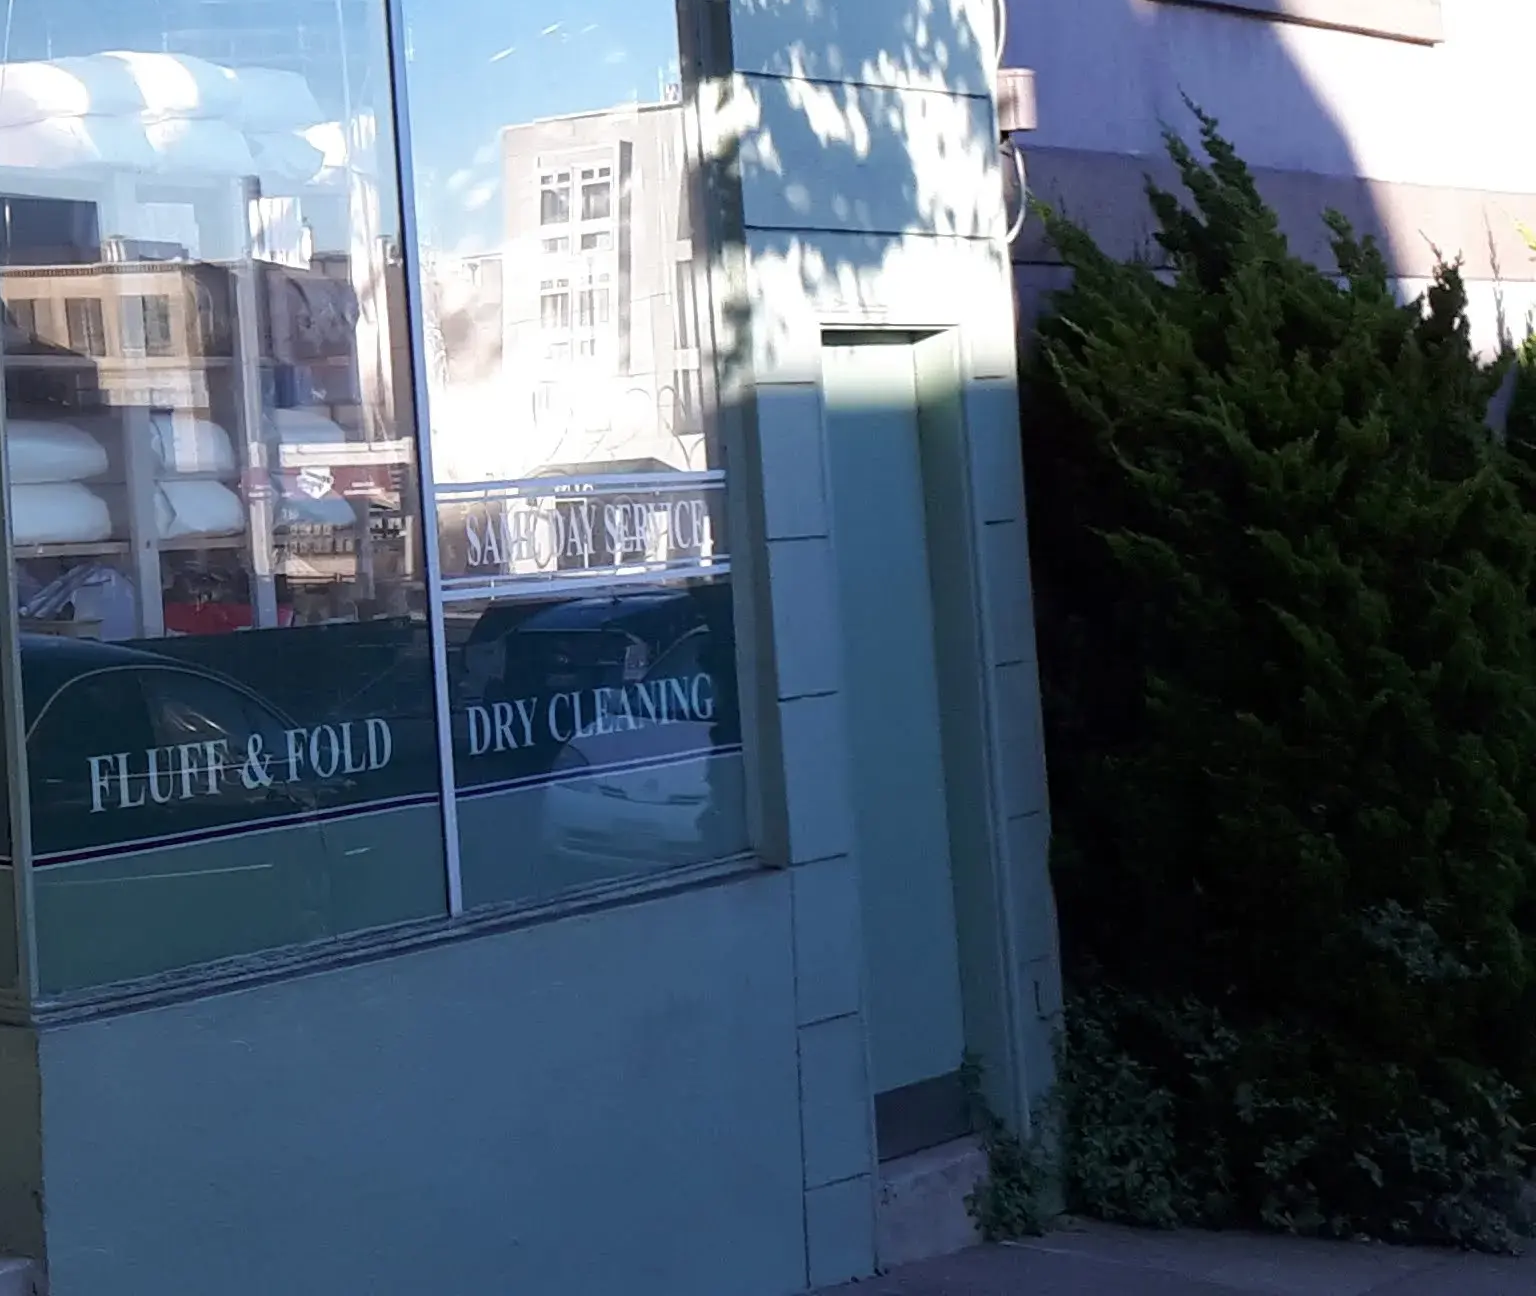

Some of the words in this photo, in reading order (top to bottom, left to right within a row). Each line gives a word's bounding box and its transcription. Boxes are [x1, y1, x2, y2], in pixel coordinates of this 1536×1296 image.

[465, 504, 540, 567] SAME
[546, 502, 597, 557] DAY
[604, 499, 709, 554] SERVICE
[465, 696, 539, 757] DRY
[547, 672, 715, 745] CLEANING
[86, 737, 229, 813] FLUFF
[237, 733, 274, 791] &
[285, 717, 393, 783] FOLD
